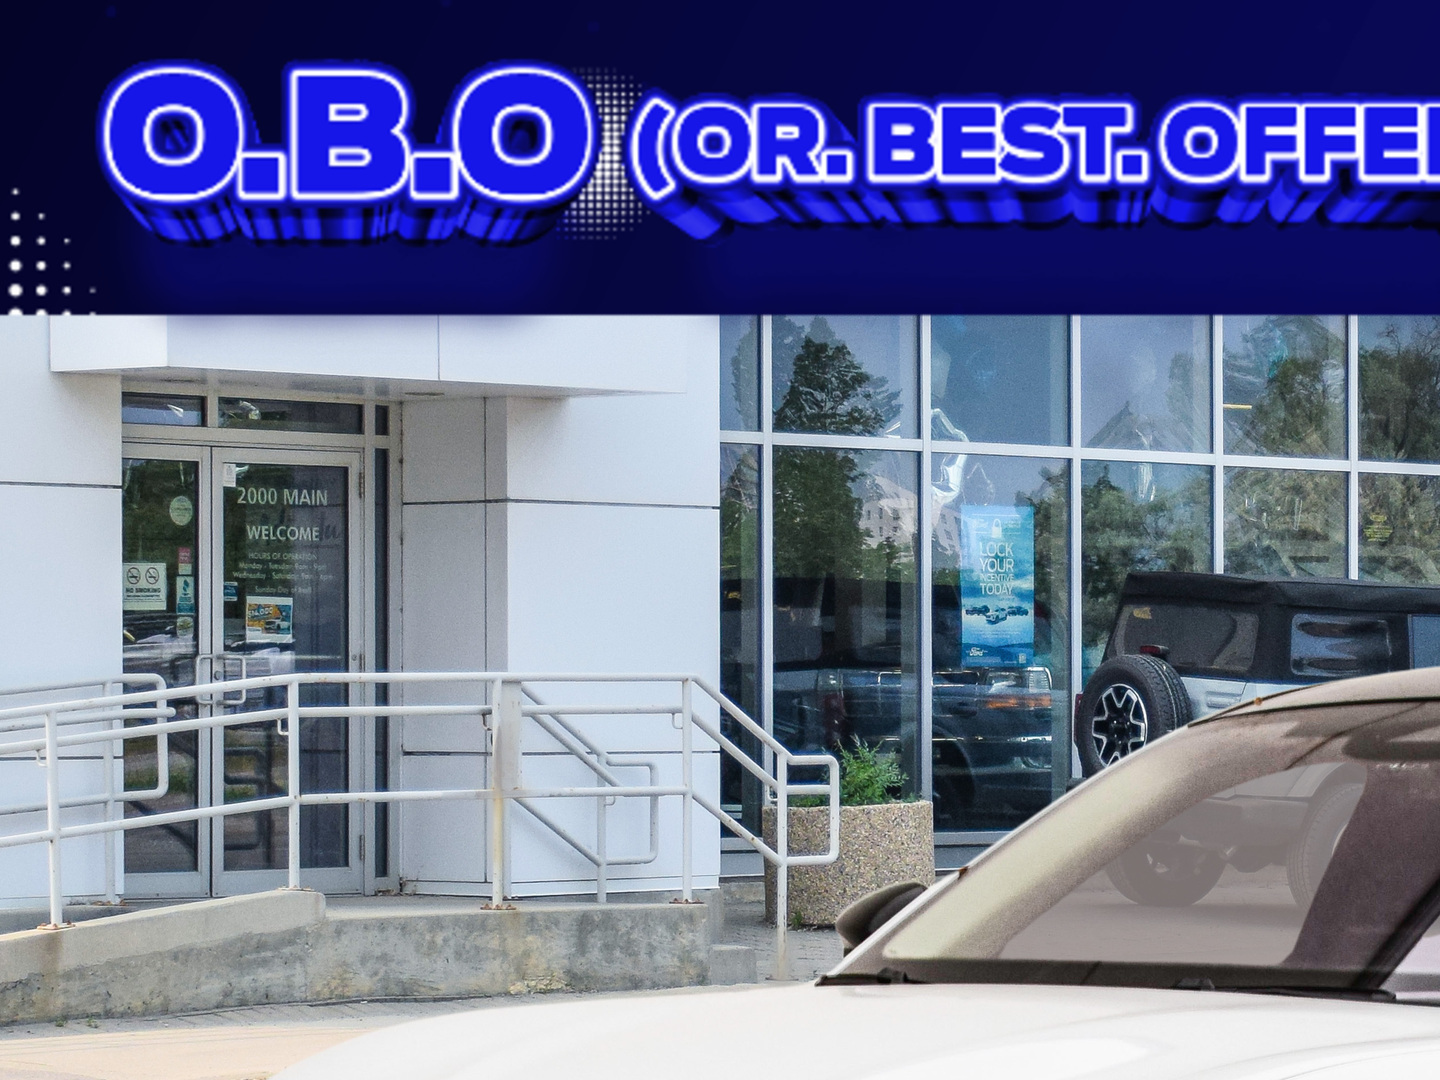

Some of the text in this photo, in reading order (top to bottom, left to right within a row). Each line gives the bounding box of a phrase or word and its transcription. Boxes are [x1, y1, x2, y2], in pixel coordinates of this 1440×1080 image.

[237, 487, 328, 506] 2000 MAIN
[246, 525, 320, 542] WELCOME
[979, 541, 1014, 557] LOCK
[980, 558, 1015, 573] YOUR
[980, 583, 1014, 595] TODAY
